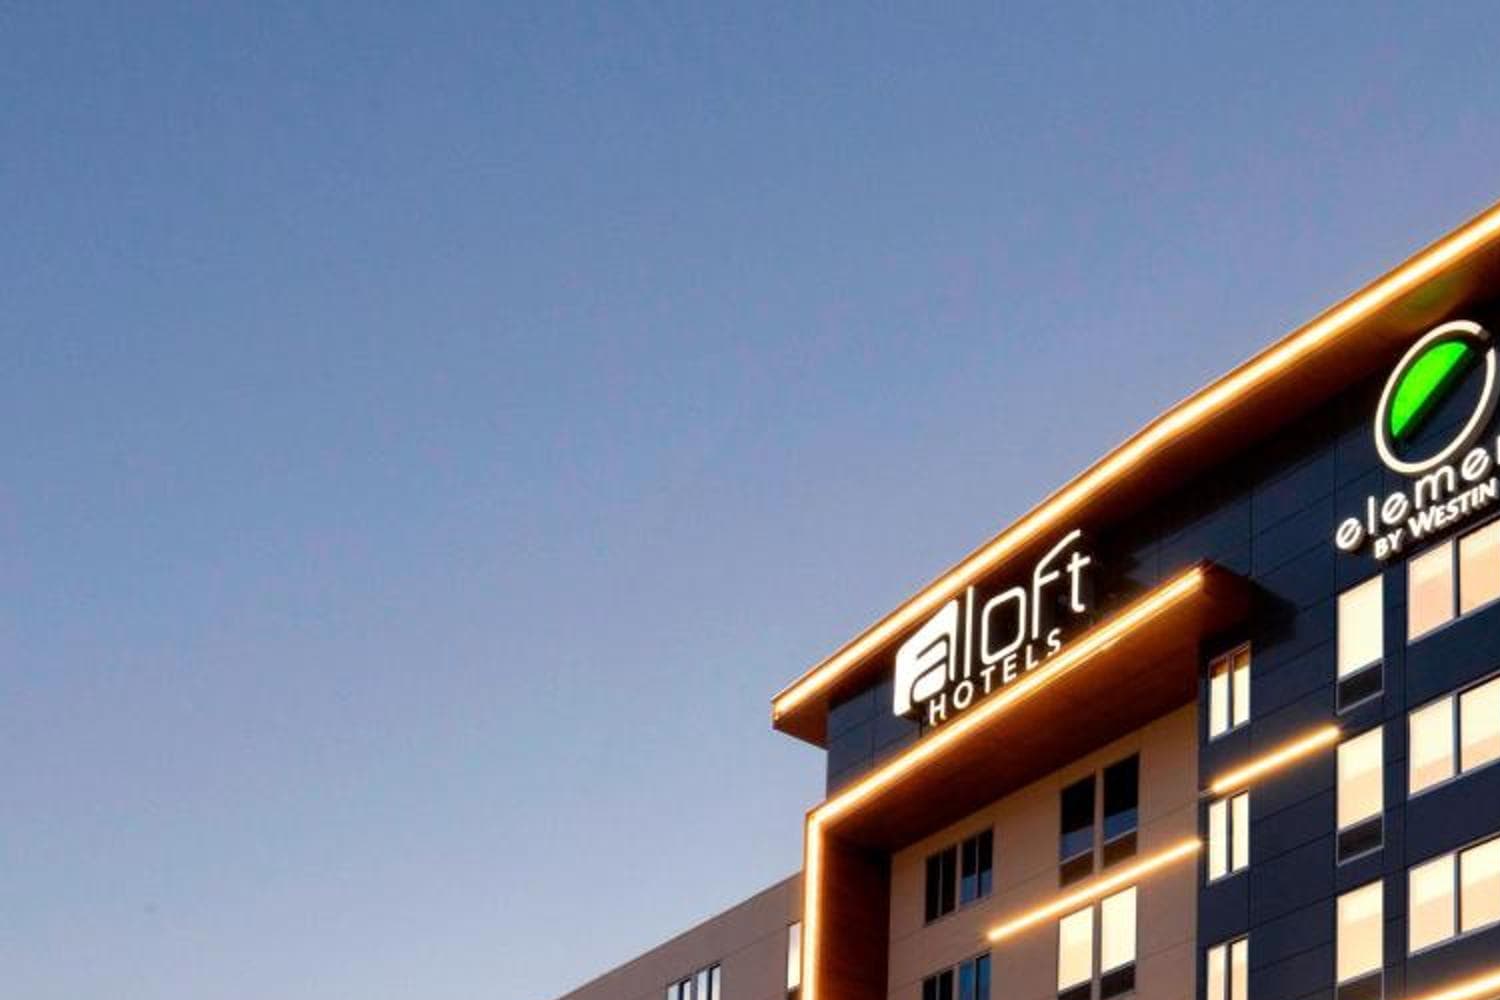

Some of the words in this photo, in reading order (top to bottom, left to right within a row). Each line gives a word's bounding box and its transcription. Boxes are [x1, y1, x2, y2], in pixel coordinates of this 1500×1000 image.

[1373, 528, 1404, 559] BY
[1407, 477, 1498, 538] WESTIN
[928, 627, 1063, 727] HOTELS
